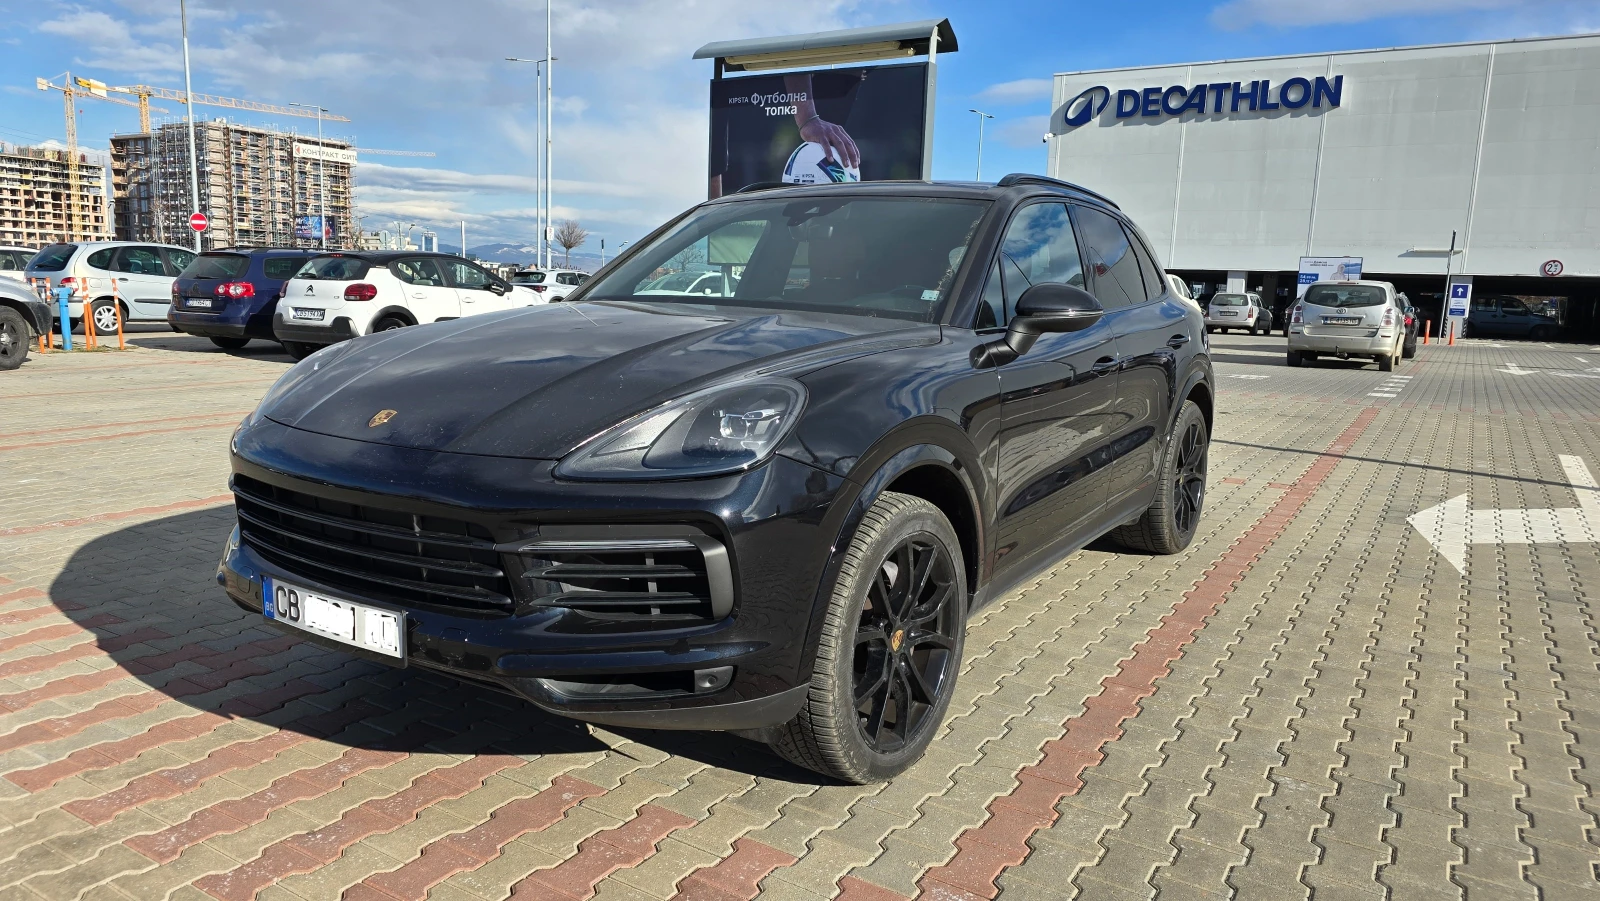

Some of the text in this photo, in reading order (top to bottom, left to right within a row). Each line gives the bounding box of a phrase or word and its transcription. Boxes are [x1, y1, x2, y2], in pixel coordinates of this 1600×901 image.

[728, 91, 807, 107] KIPSTA Футболна
[1116, 75, 1344, 119] DECATHLON
[764, 105, 798, 116] топка
[302, 148, 339, 158] КОНТРАКТ
[265, 601, 274, 612] BG
[275, 585, 300, 622] CB
